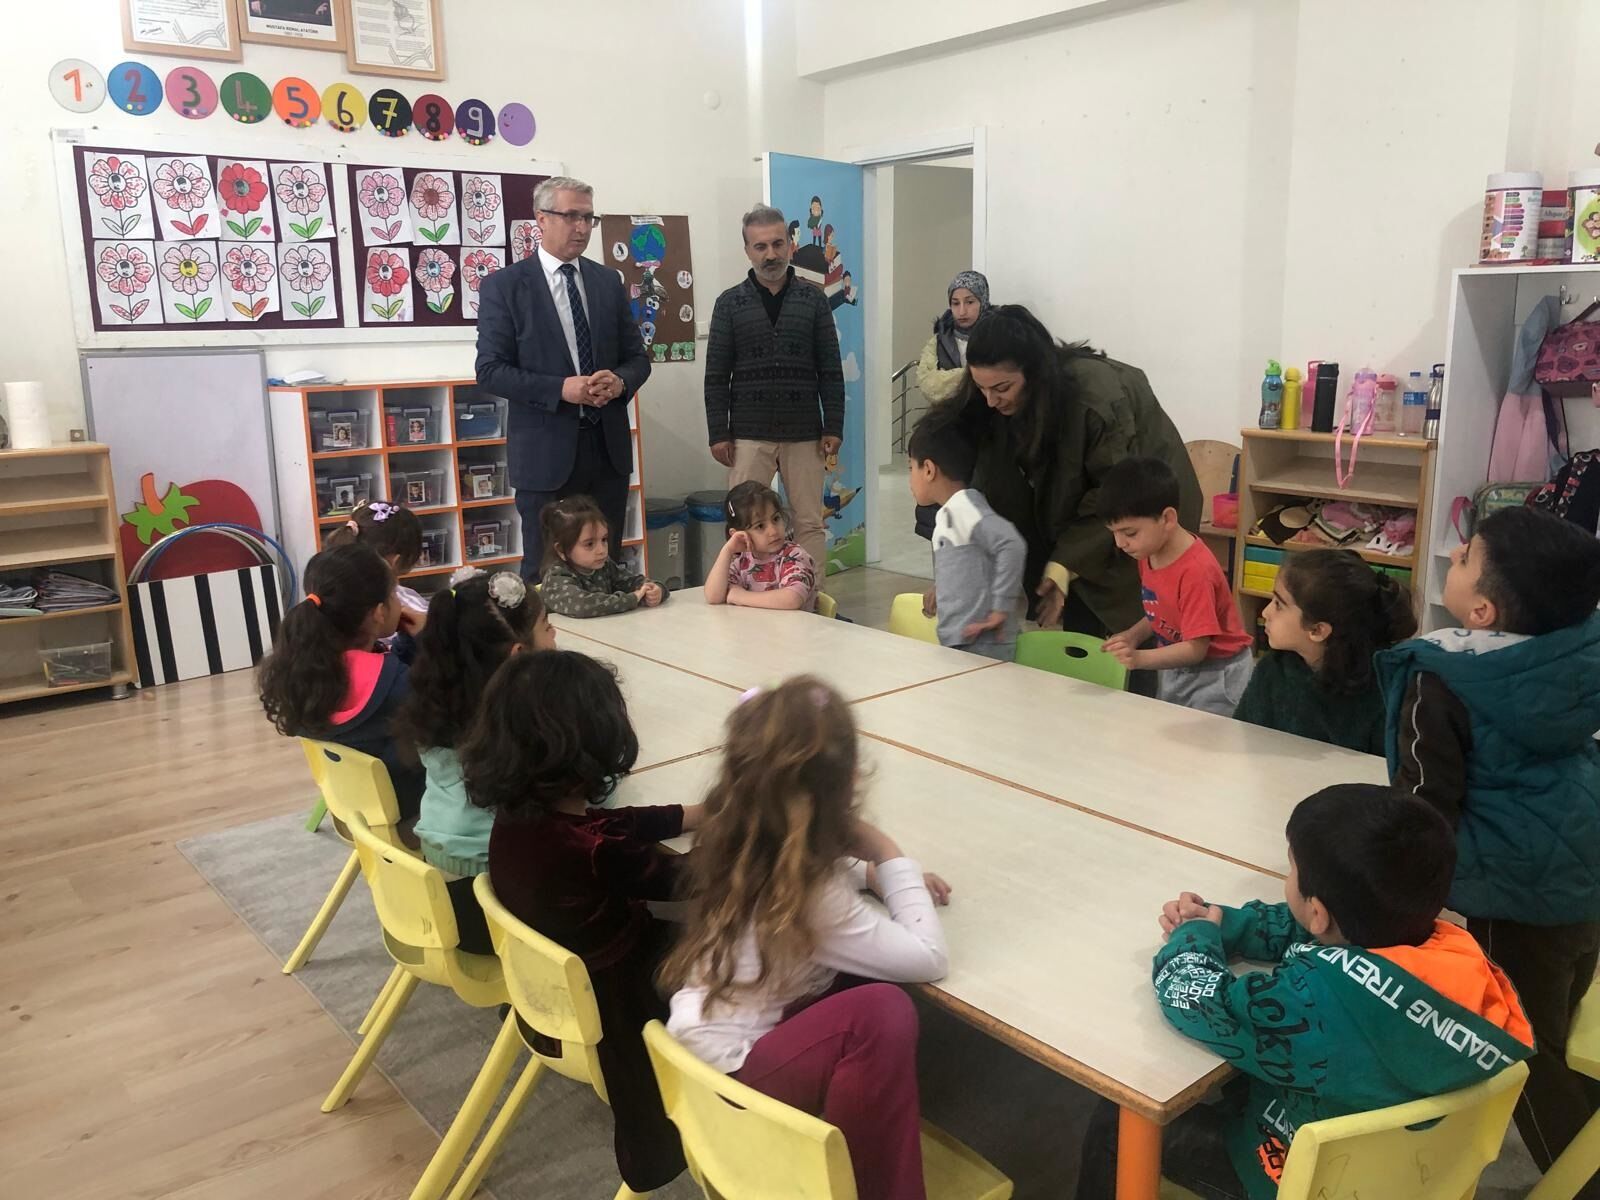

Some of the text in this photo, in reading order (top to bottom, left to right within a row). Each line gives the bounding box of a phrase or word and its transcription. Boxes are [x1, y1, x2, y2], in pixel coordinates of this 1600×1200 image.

[63, 68, 483, 138] 1 2 3 4 5 6 7 8 9
[1317, 946, 1404, 1010] TREND
